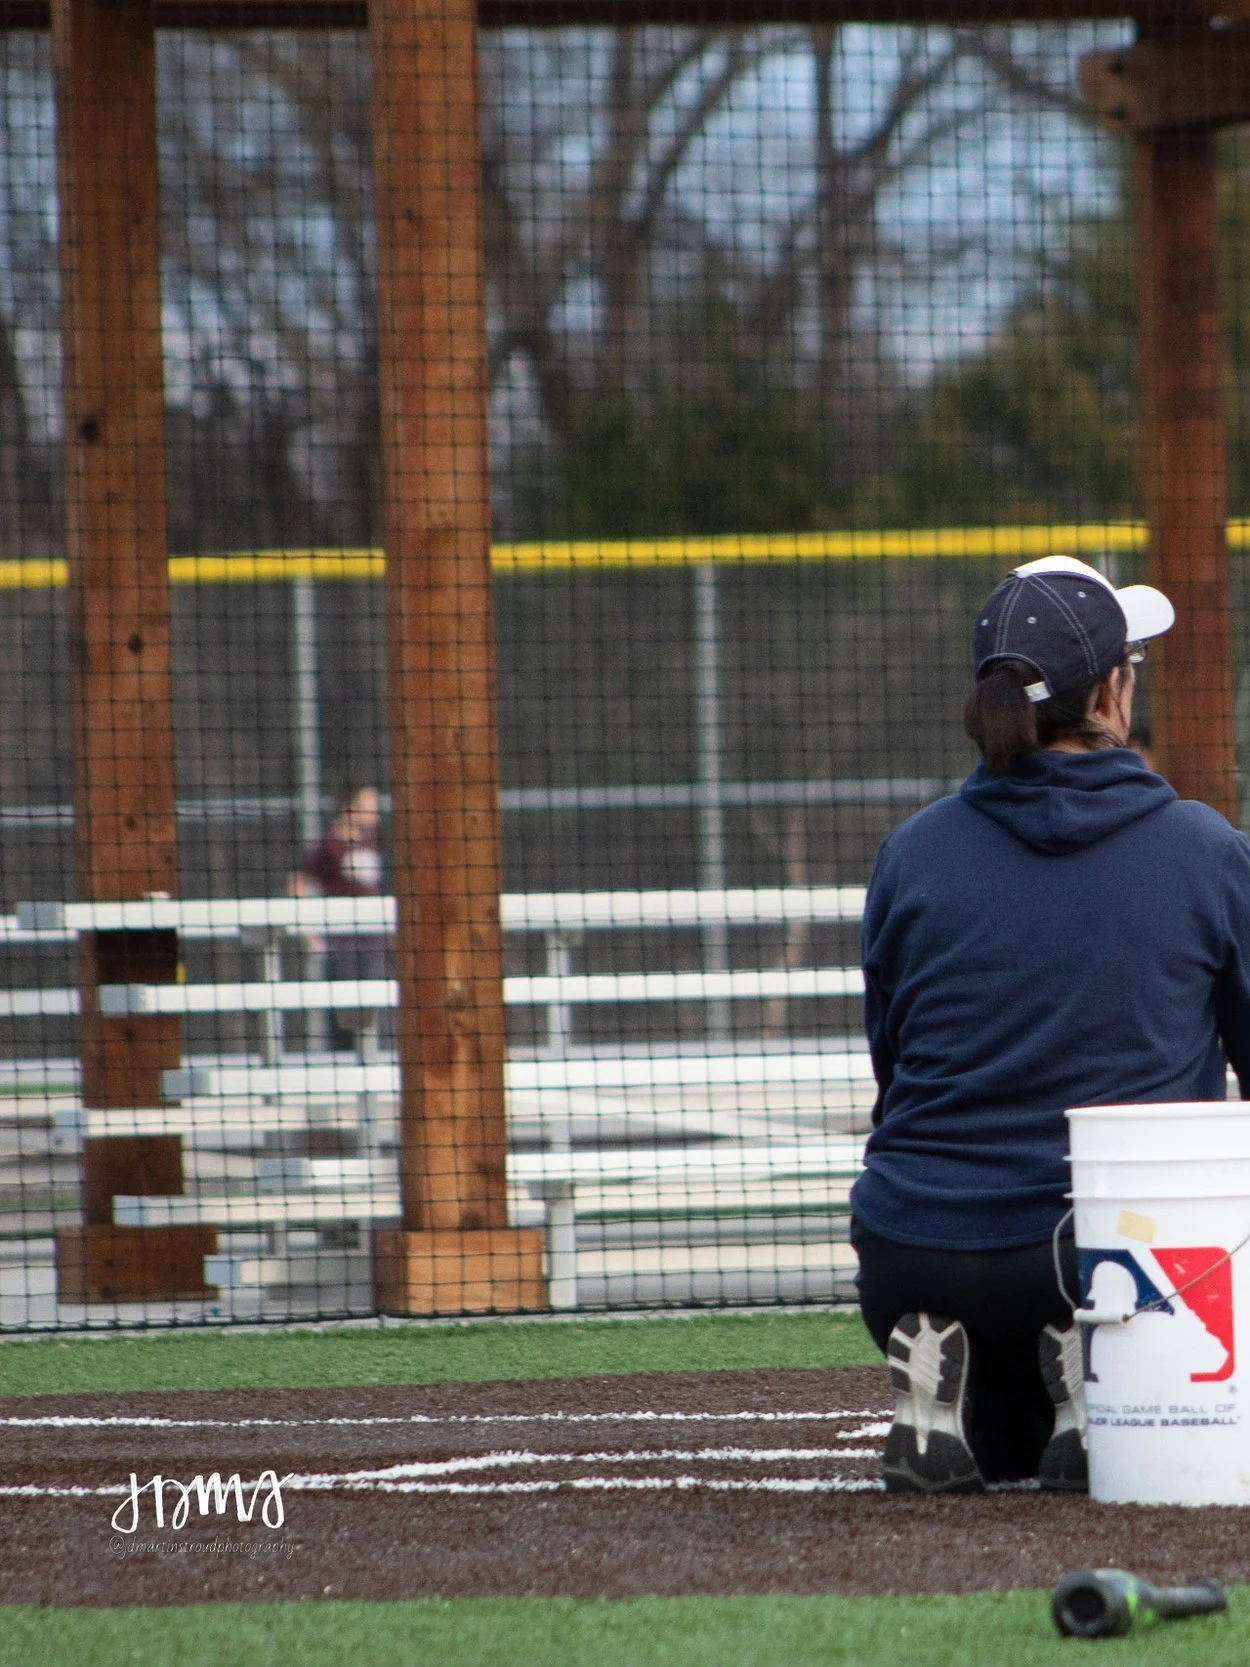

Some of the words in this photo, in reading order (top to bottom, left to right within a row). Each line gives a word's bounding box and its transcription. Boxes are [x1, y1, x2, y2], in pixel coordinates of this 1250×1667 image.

[1122, 1404, 1162, 1415] GAME
[1168, 1403, 1208, 1414] BALL
[1214, 1403, 1237, 1413] OF
[1111, 1417, 1155, 1427] LEAGUE
[1160, 1417, 1238, 1427] BASEBALL
